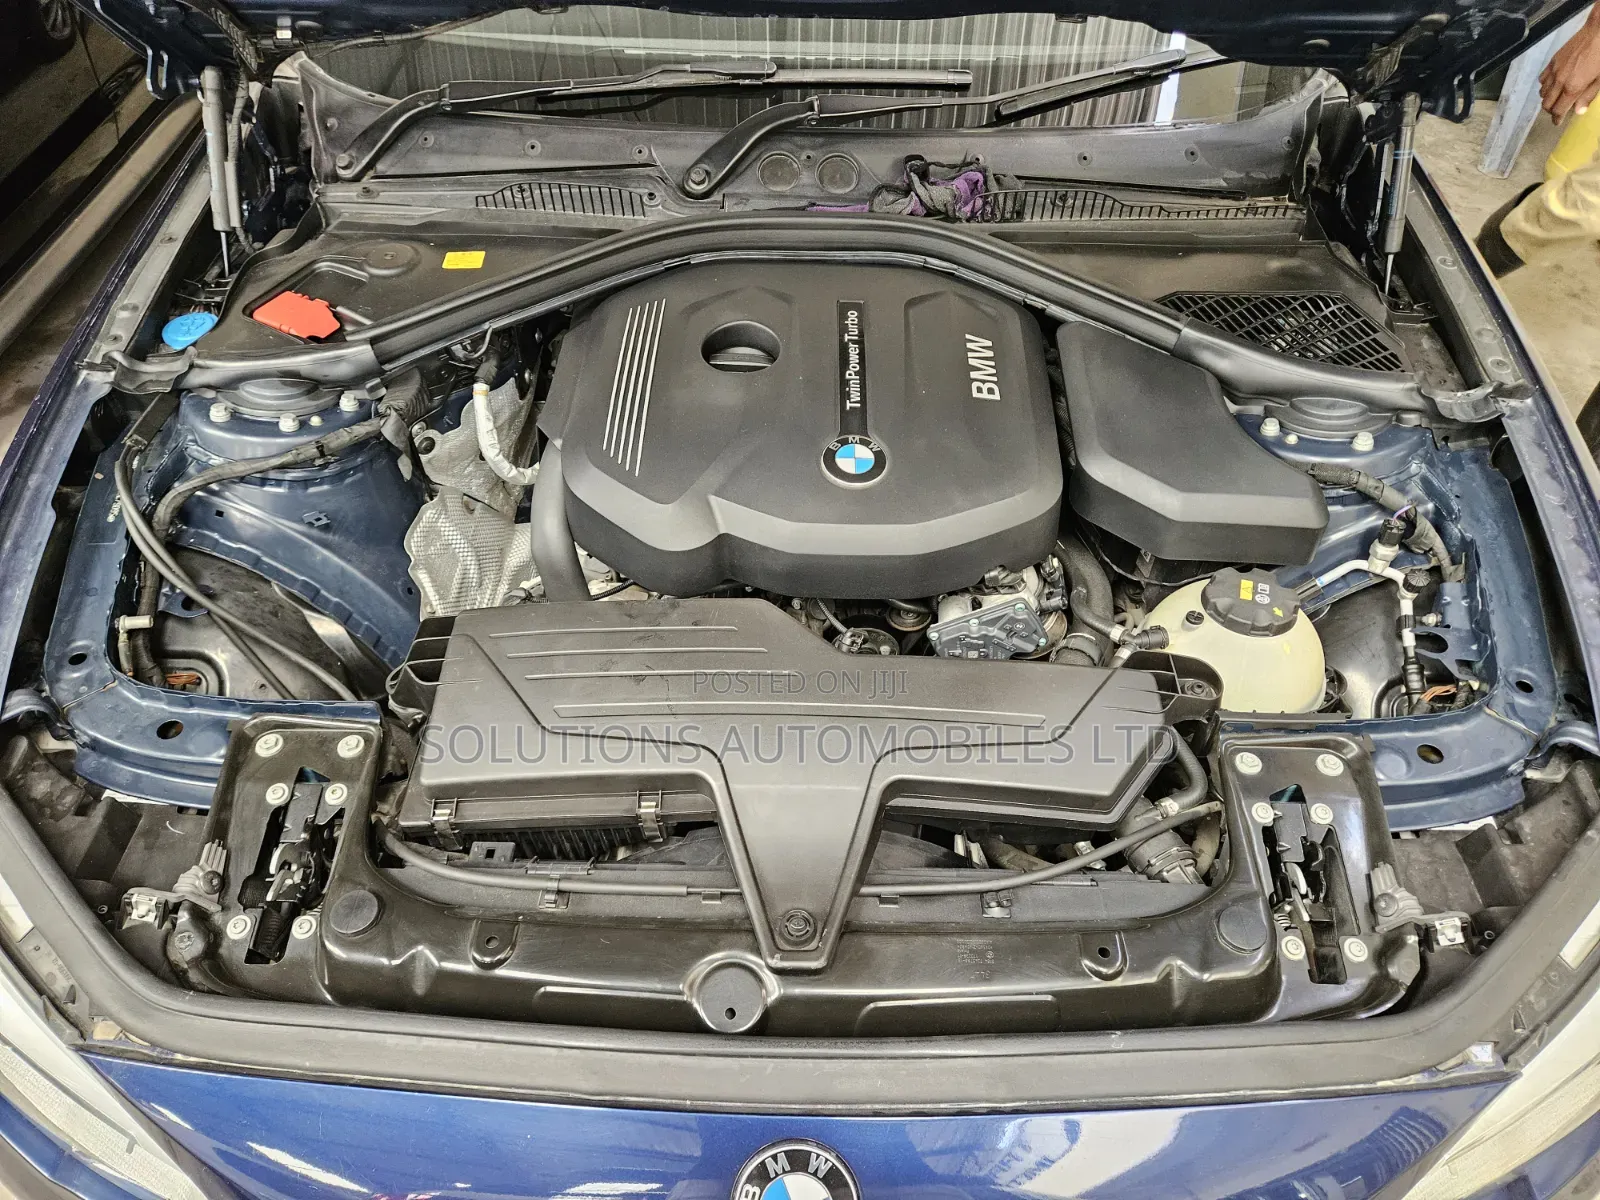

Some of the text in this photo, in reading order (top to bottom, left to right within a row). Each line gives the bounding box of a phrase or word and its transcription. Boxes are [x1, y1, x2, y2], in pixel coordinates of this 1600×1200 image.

[845, 310, 861, 410] TwinPower Turbo
[965, 333, 1001, 401] BMW
[829, 436, 881, 452] BMW
[740, 1152, 833, 1200] BMW
